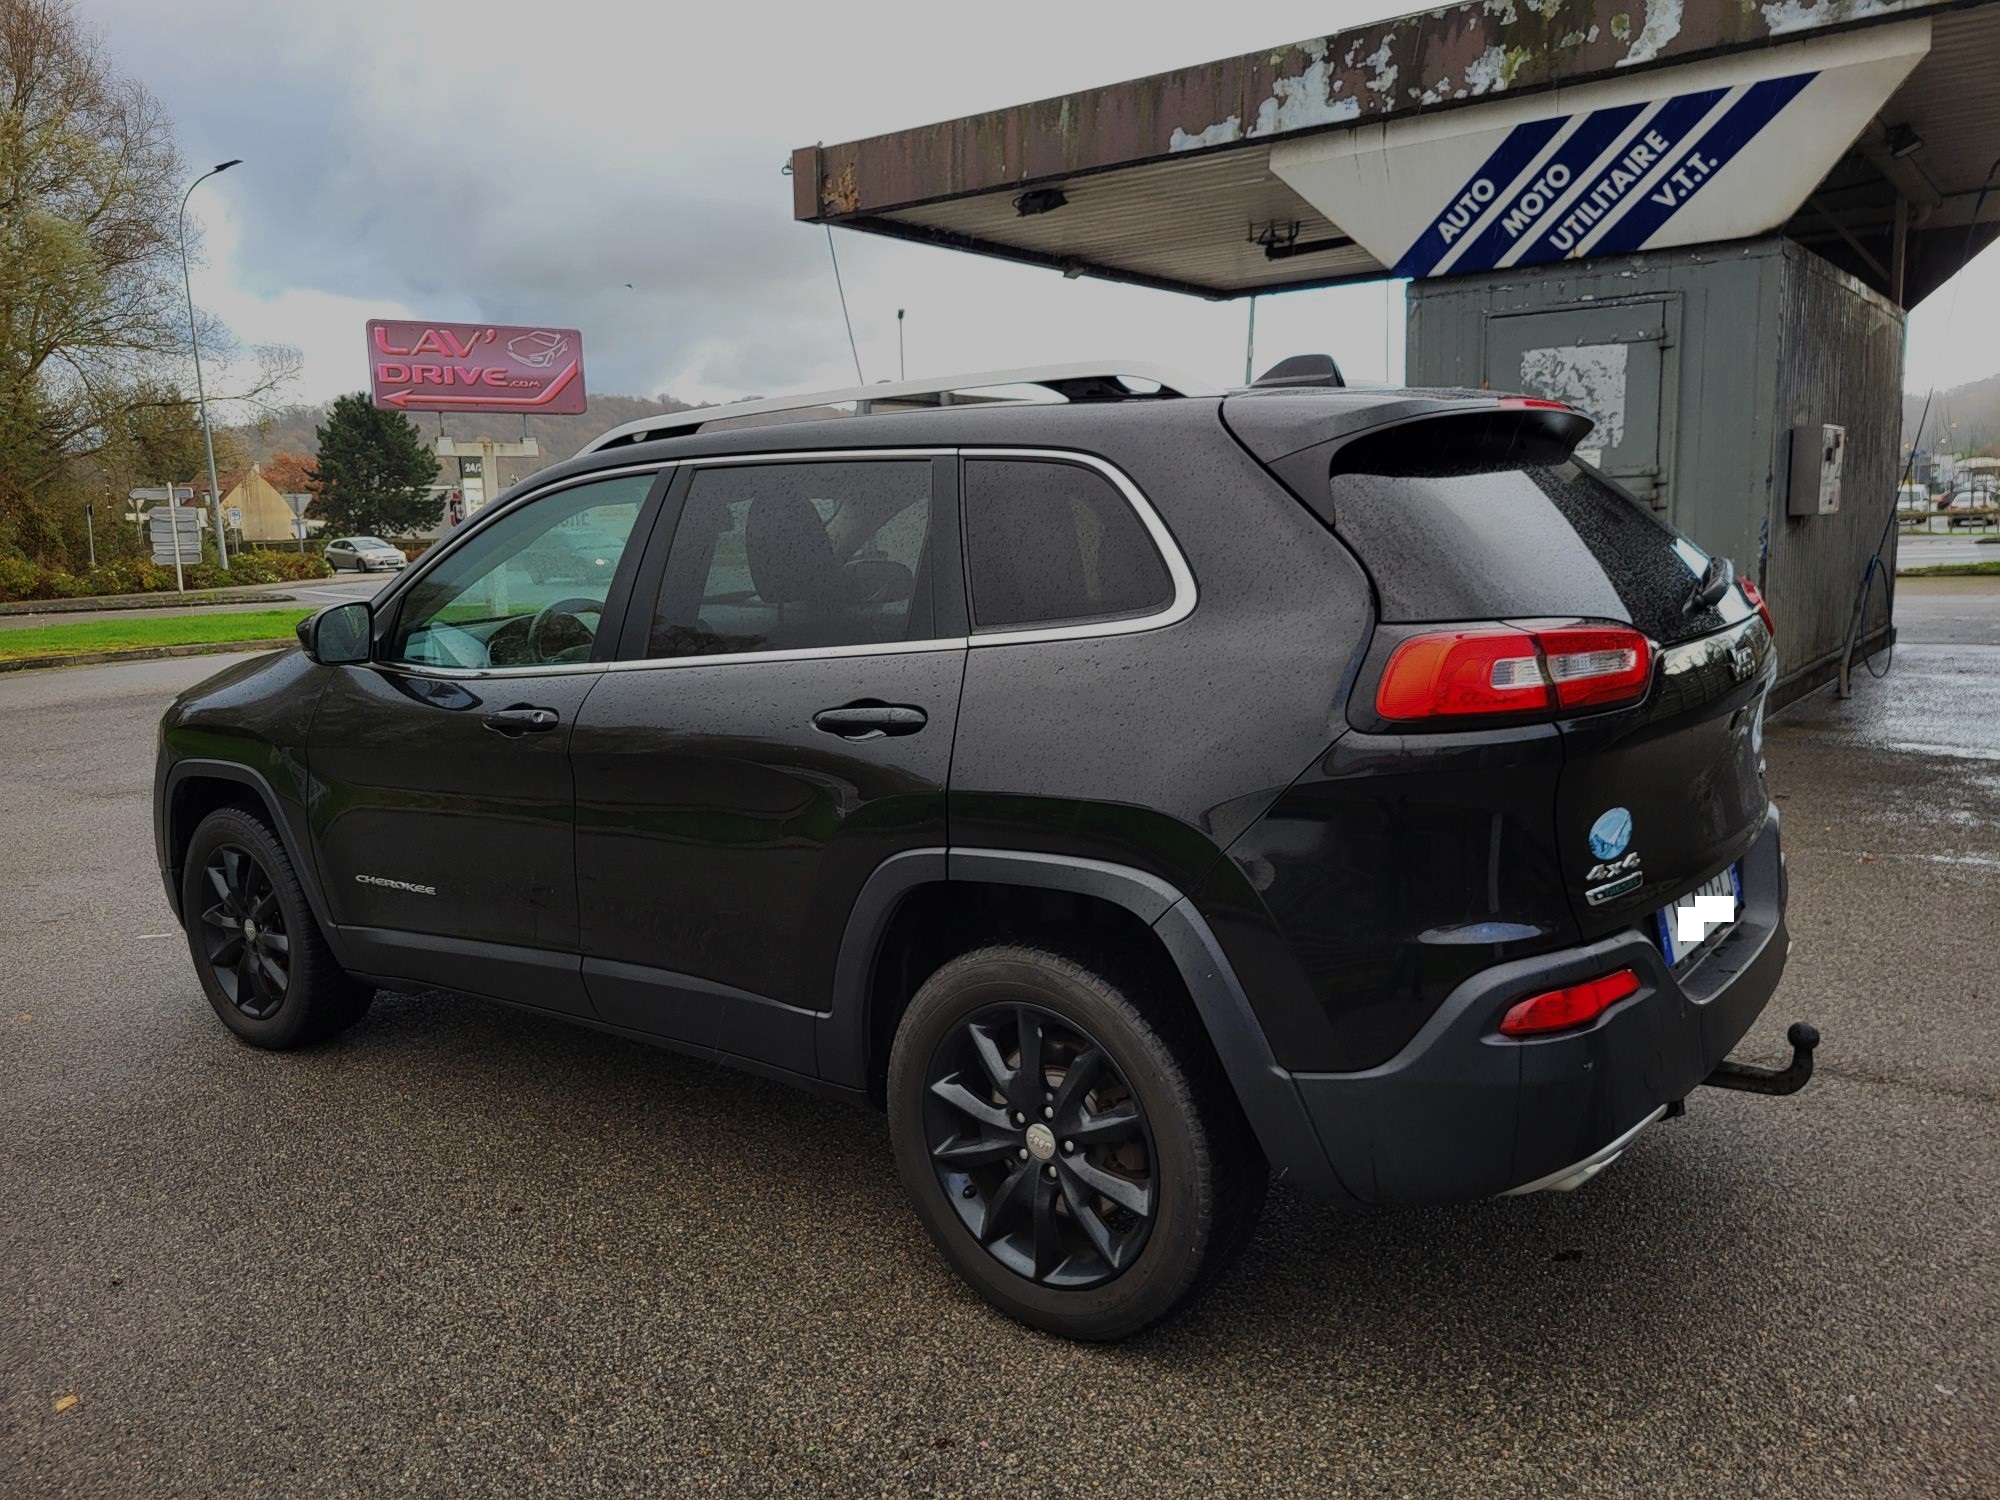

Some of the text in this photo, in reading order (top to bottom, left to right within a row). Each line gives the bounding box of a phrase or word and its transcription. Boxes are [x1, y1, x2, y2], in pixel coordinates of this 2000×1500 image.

[1436, 178, 1496, 245] AUTO
[1500, 163, 1571, 239] MOTO
[1548, 128, 1670, 252] UTILITAIRE
[1650, 152, 1719, 209] V.T.T.
[374, 326, 498, 358] LAV'
[355, 874, 437, 896] CHEROKEE
